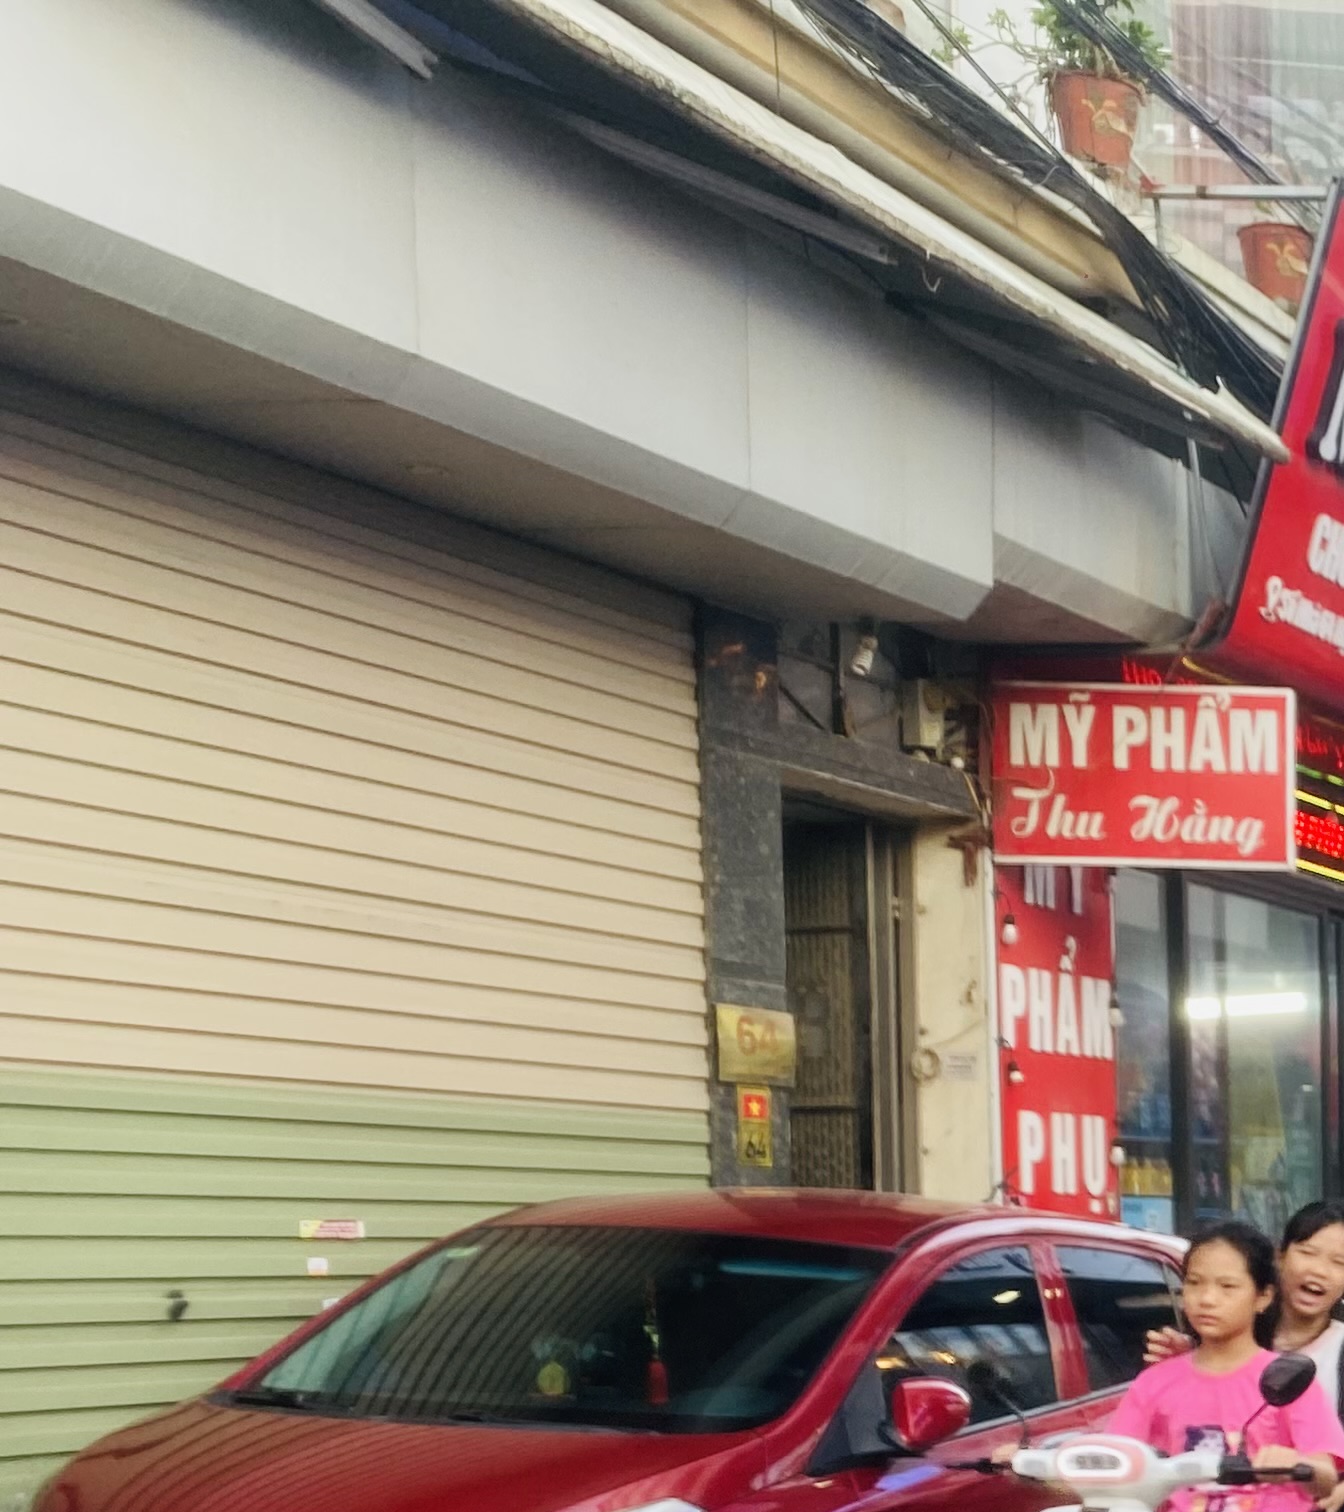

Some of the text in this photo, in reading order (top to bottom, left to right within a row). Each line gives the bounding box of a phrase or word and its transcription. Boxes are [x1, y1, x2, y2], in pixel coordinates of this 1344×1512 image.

[1009, 692, 1095, 769] MỸ
[1111, 693, 1280, 775] PHẨM
[1010, 767, 1106, 841] Thu
[1129, 796, 1266, 857] Hằng
[1000, 934, 1114, 1061] PHẨM
[1017, 1108, 1108, 1215] PHỤ
